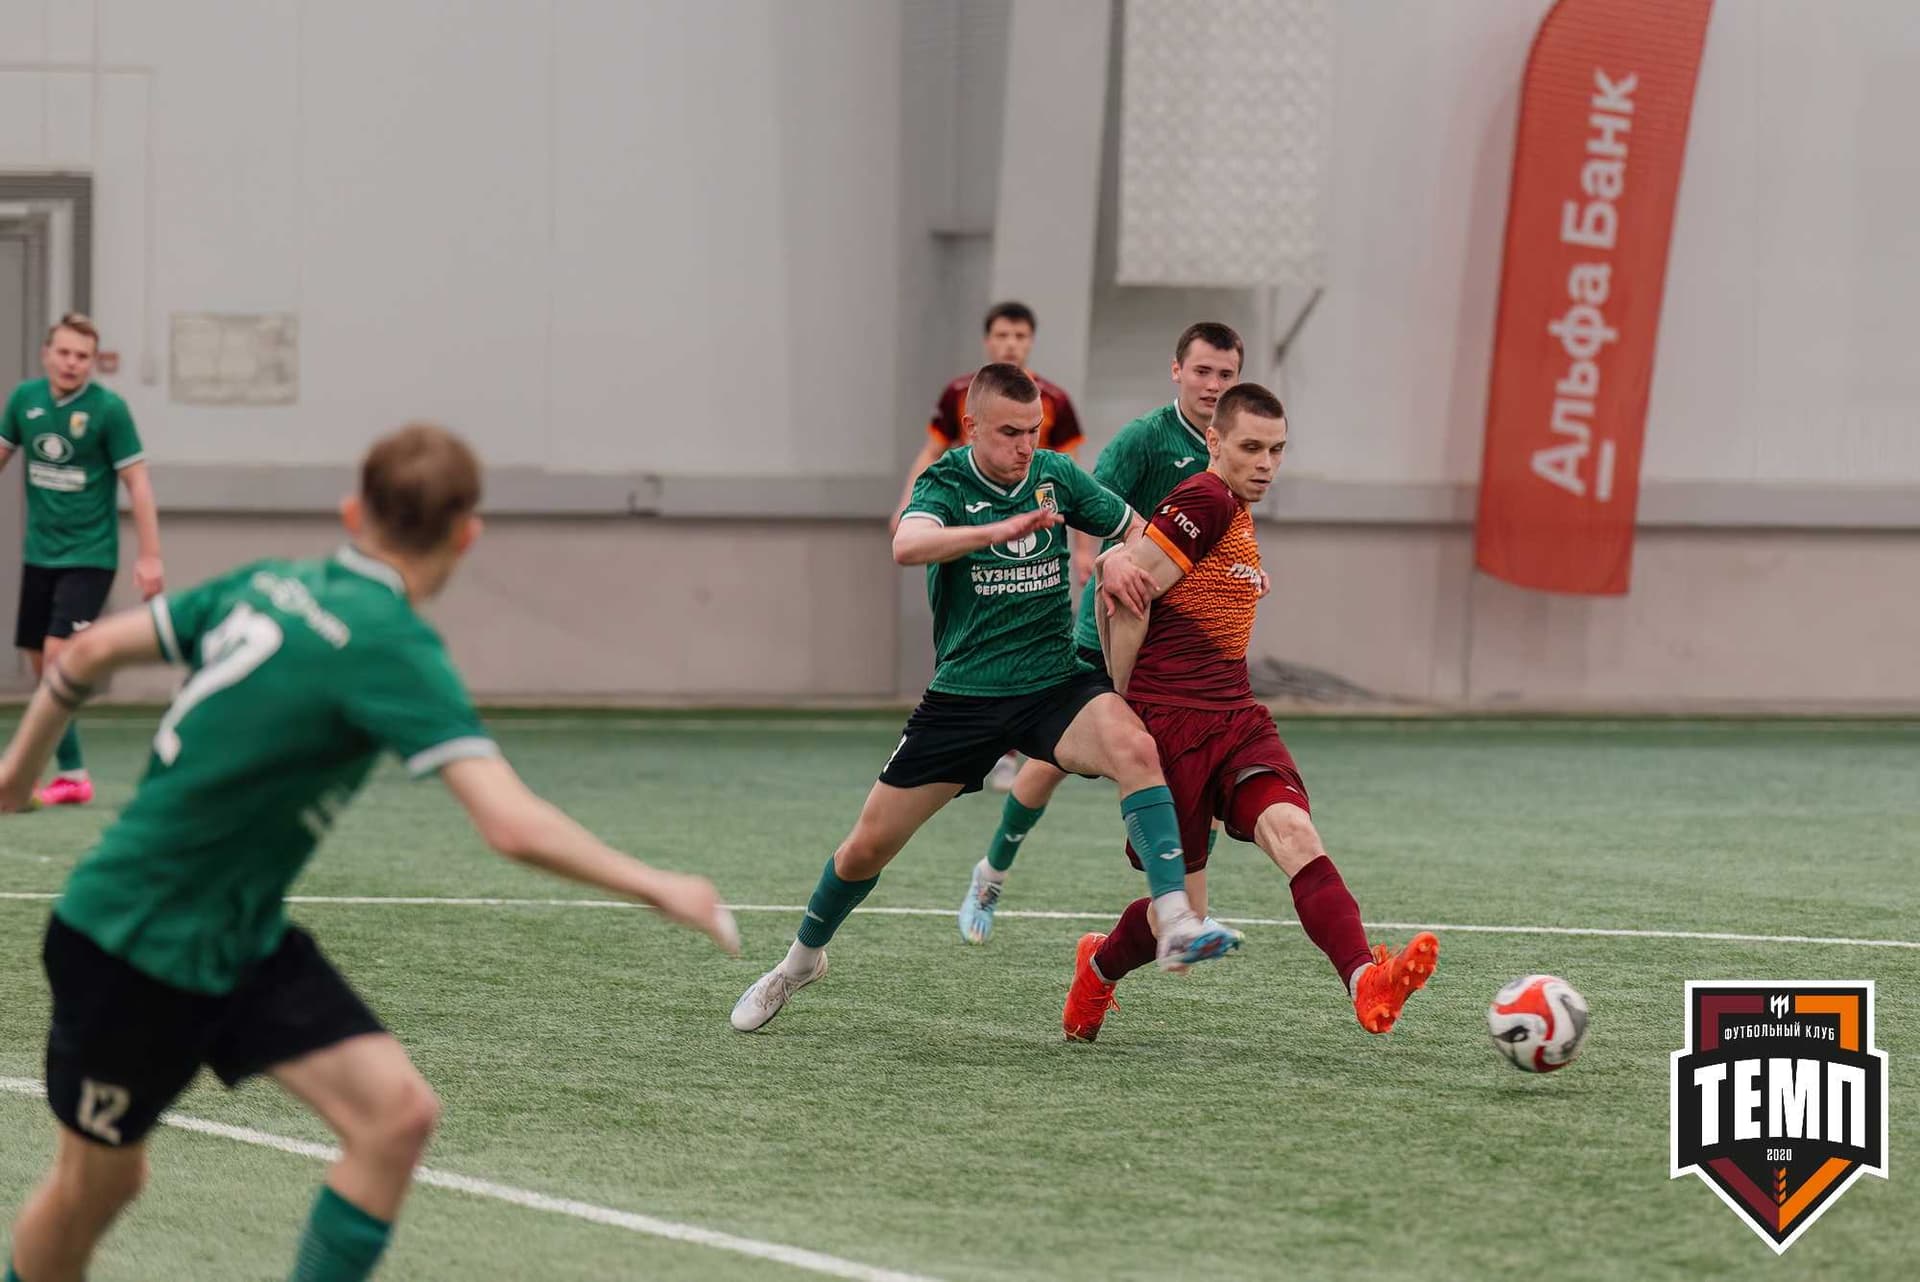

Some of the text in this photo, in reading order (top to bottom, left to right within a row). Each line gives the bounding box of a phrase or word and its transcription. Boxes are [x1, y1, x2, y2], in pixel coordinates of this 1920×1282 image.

[1530, 68, 1638, 498] Альфа Банк
[1173, 511, 1201, 539] ПСБ
[971, 558, 1061, 583] КУЗНЕЦКИЕ
[974, 573, 1061, 596] ФЕРРОСПЛАВЫ
[77, 1077, 130, 1146] 12
